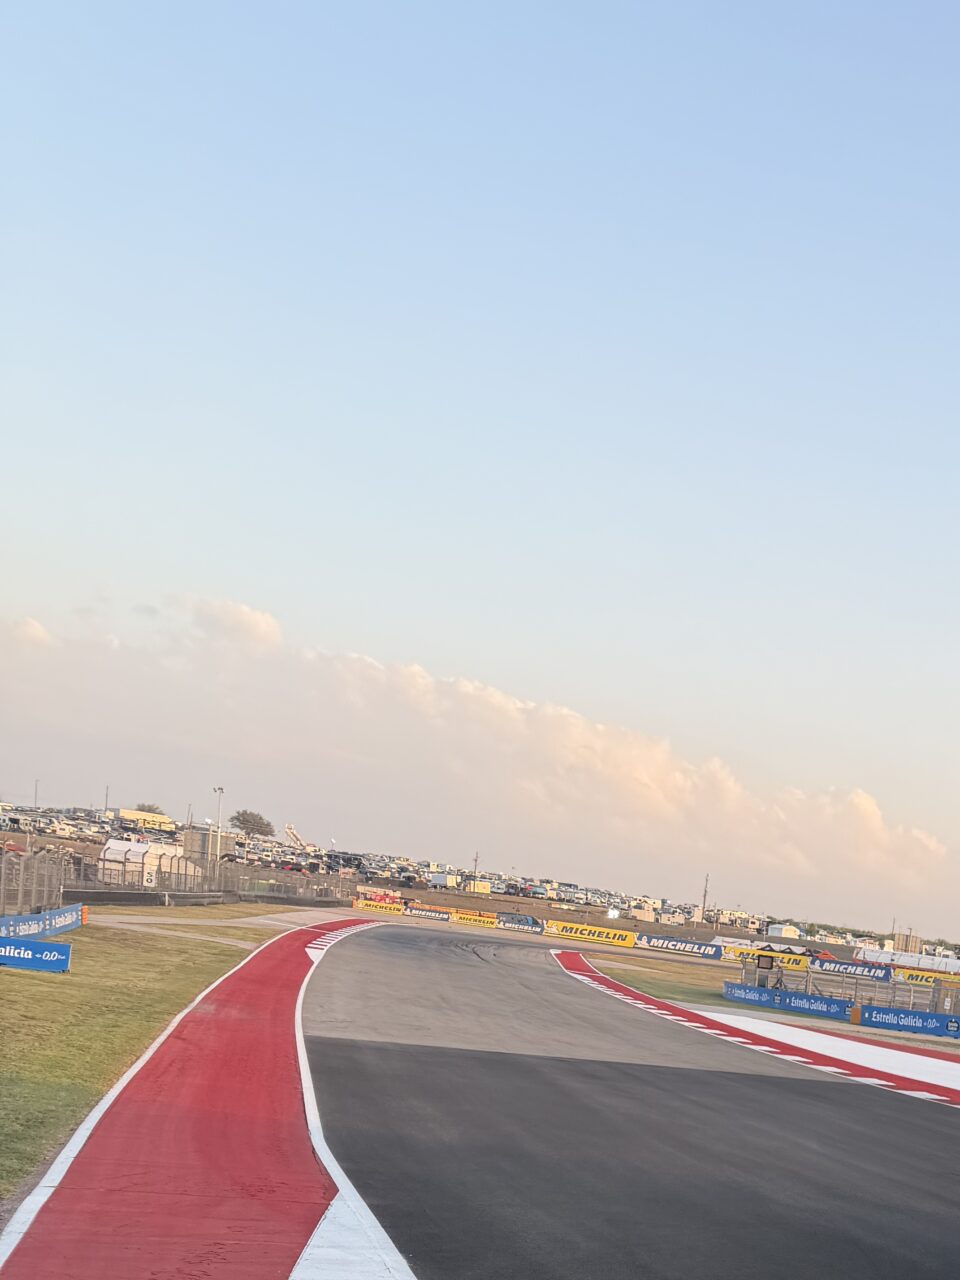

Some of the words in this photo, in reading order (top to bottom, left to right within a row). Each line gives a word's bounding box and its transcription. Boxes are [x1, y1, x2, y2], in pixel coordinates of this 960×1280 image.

[561, 925, 628, 942] MICHELIN
[650, 938, 716, 955] MICHELIN
[822, 963, 886, 978] MICHELIN
[872, 1011, 898, 1025] Estrella
[898, 1014, 922, 1028] Galicia
